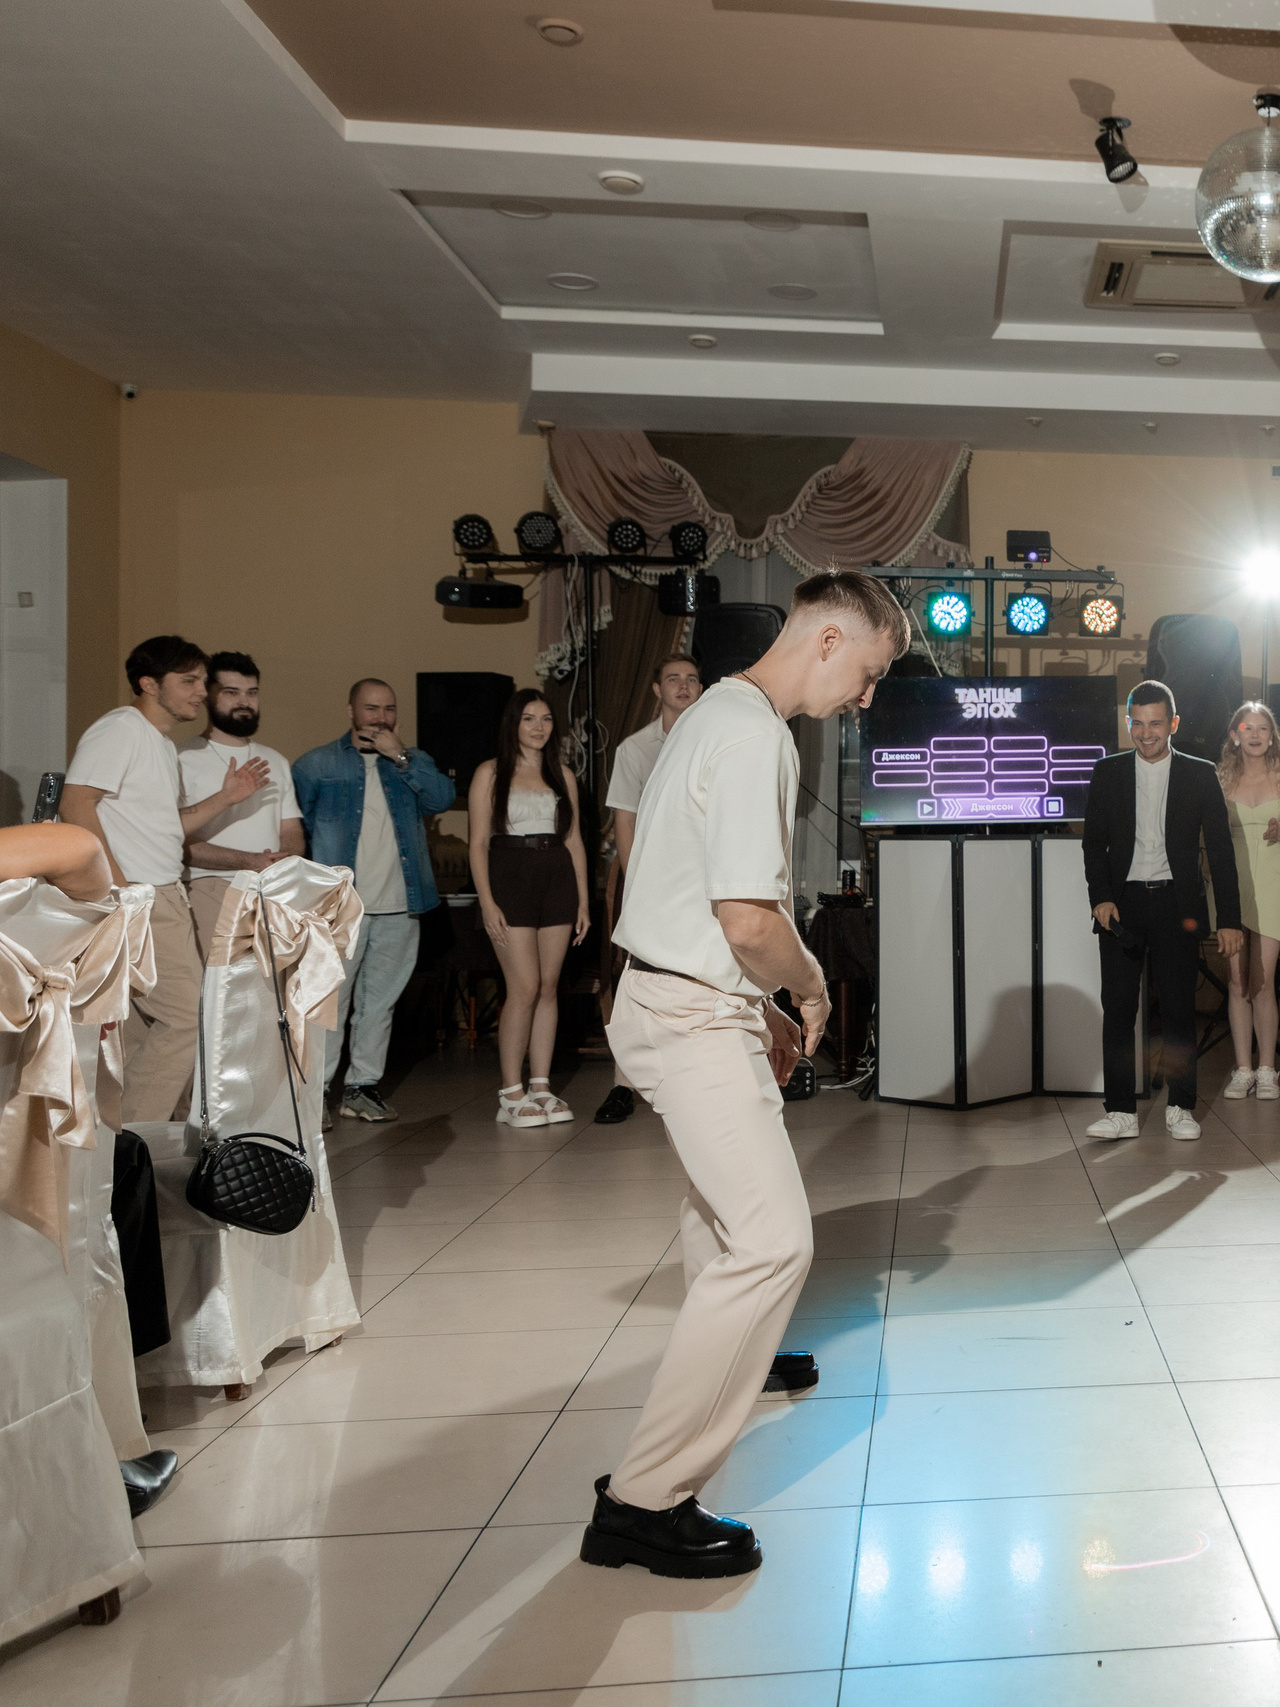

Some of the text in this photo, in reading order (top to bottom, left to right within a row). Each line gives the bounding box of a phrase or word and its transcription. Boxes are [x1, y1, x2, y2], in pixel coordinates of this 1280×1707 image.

[954, 687, 1022, 704] ТАНЦЫ
[961, 703, 1017, 719] ЭПОХ
[881, 752, 921, 762] Джексон
[970, 803, 1014, 813] Джексон
